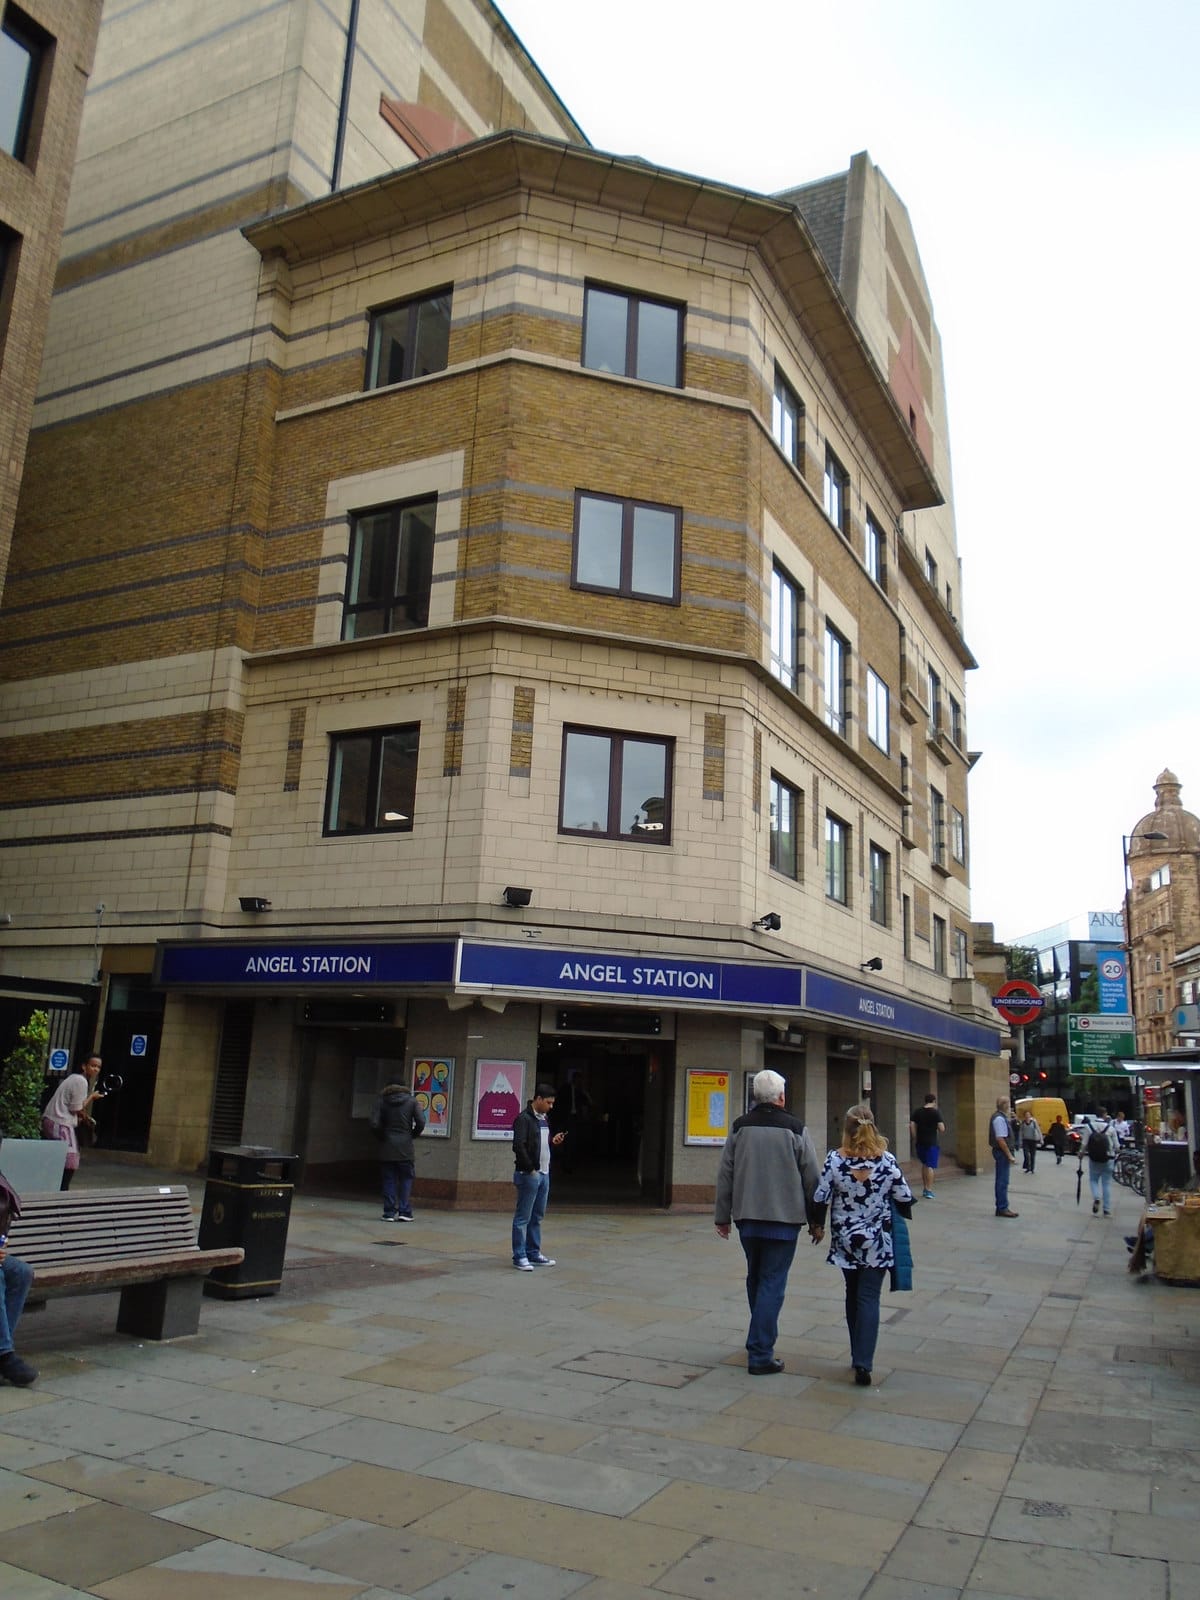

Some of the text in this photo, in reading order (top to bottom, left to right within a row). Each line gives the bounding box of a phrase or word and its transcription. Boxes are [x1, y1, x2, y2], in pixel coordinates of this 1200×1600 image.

[246, 956, 371, 973] ANGEL STATION
[1105, 964, 1120, 974] 20
[559, 962, 714, 990] ANGEL STATION
[859, 997, 895, 1020] ANGEL STATION
